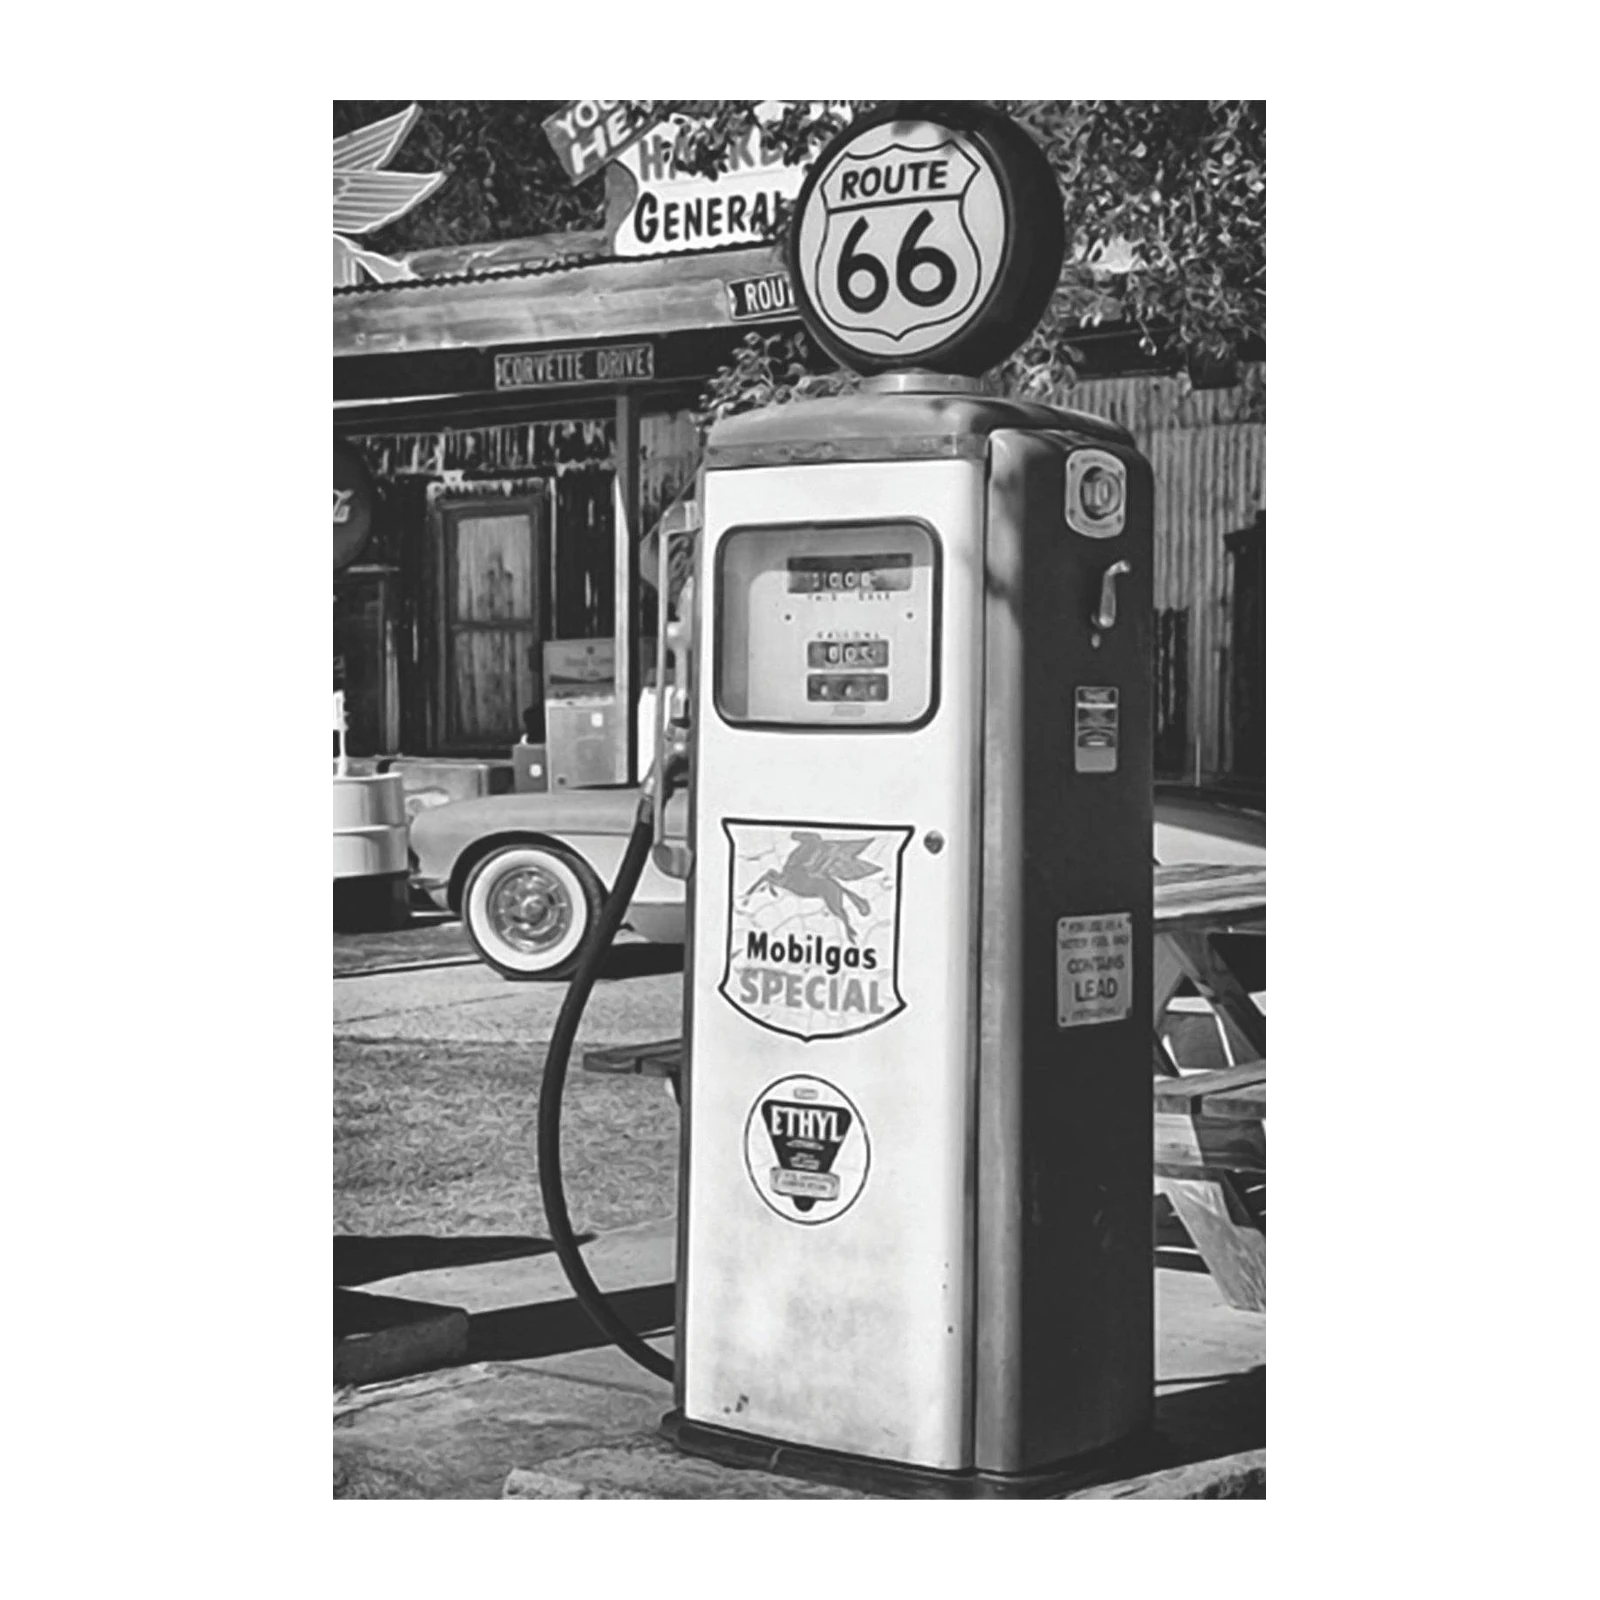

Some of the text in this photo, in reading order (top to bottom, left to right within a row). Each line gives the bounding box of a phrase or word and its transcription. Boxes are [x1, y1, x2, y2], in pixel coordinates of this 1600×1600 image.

[841, 160, 949, 200] ROUTE
[837, 208, 957, 314] 66
[502, 348, 645, 386] CORVETTE DRIVE
[747, 931, 877, 975] Mobilgas
[739, 969, 885, 1014] SPECIAL
[1075, 977, 1118, 1003] LEAD
[771, 1105, 845, 1142] ETHYL
